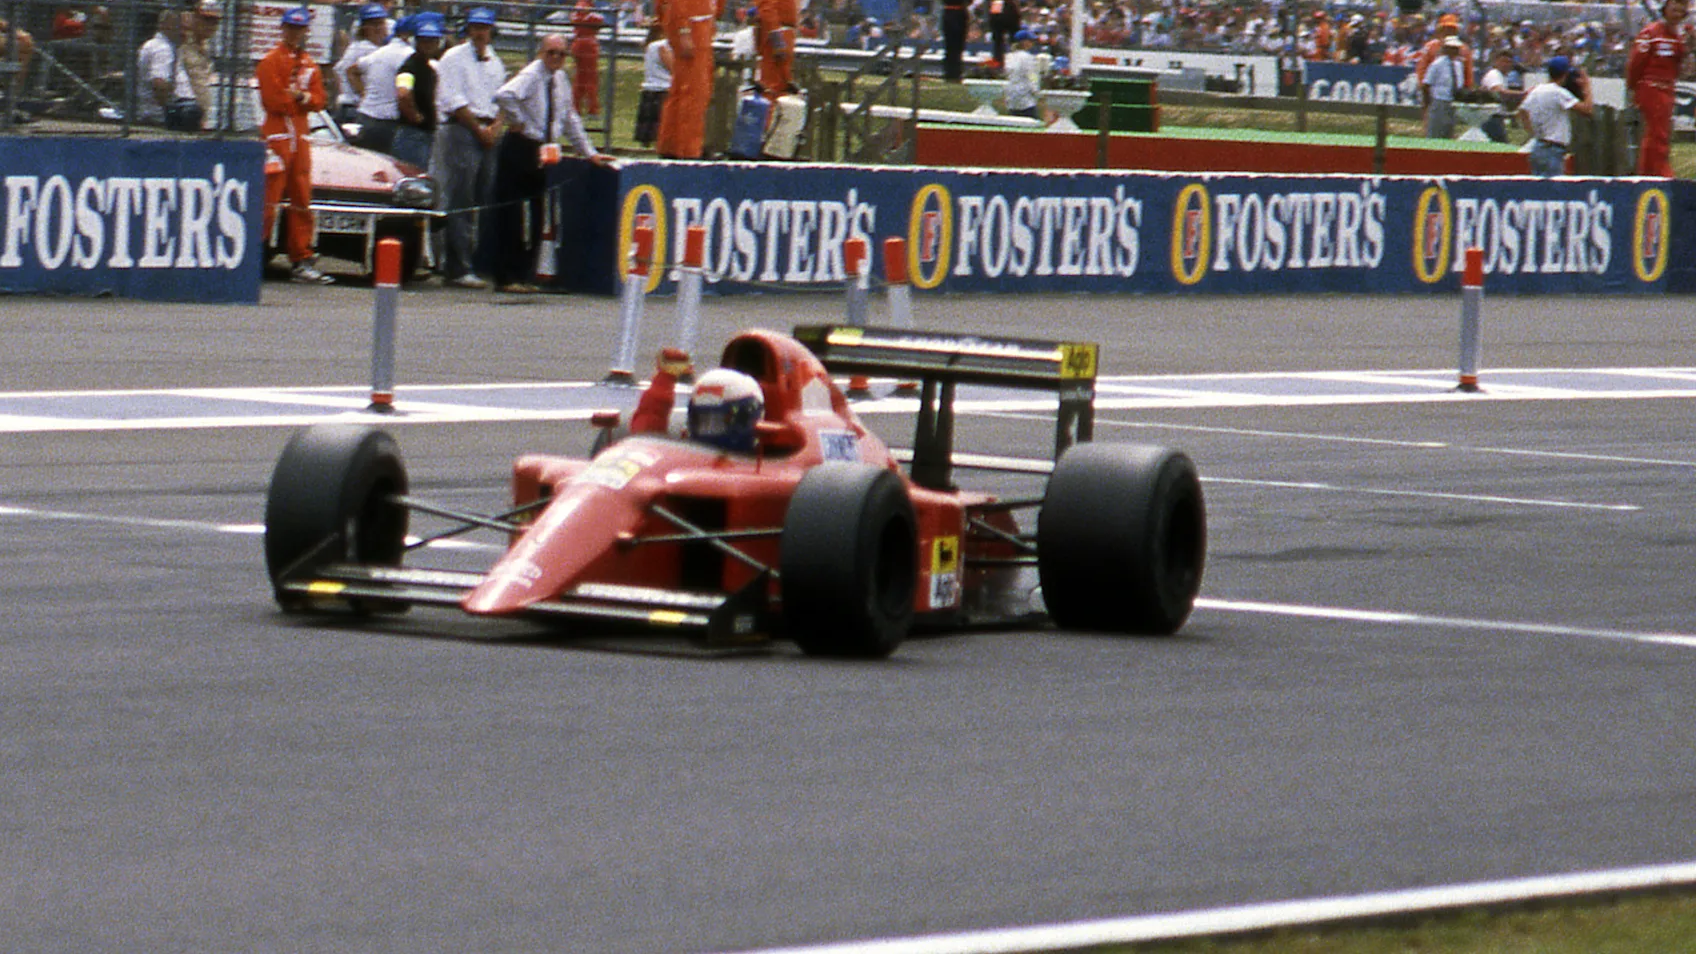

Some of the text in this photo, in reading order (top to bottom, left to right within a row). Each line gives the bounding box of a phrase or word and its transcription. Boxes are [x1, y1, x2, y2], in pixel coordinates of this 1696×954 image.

[952, 184, 1143, 278] FOSTER'S
[1211, 179, 1387, 272] FOSTER'S
[1452, 188, 1614, 275] FOSTER'S
